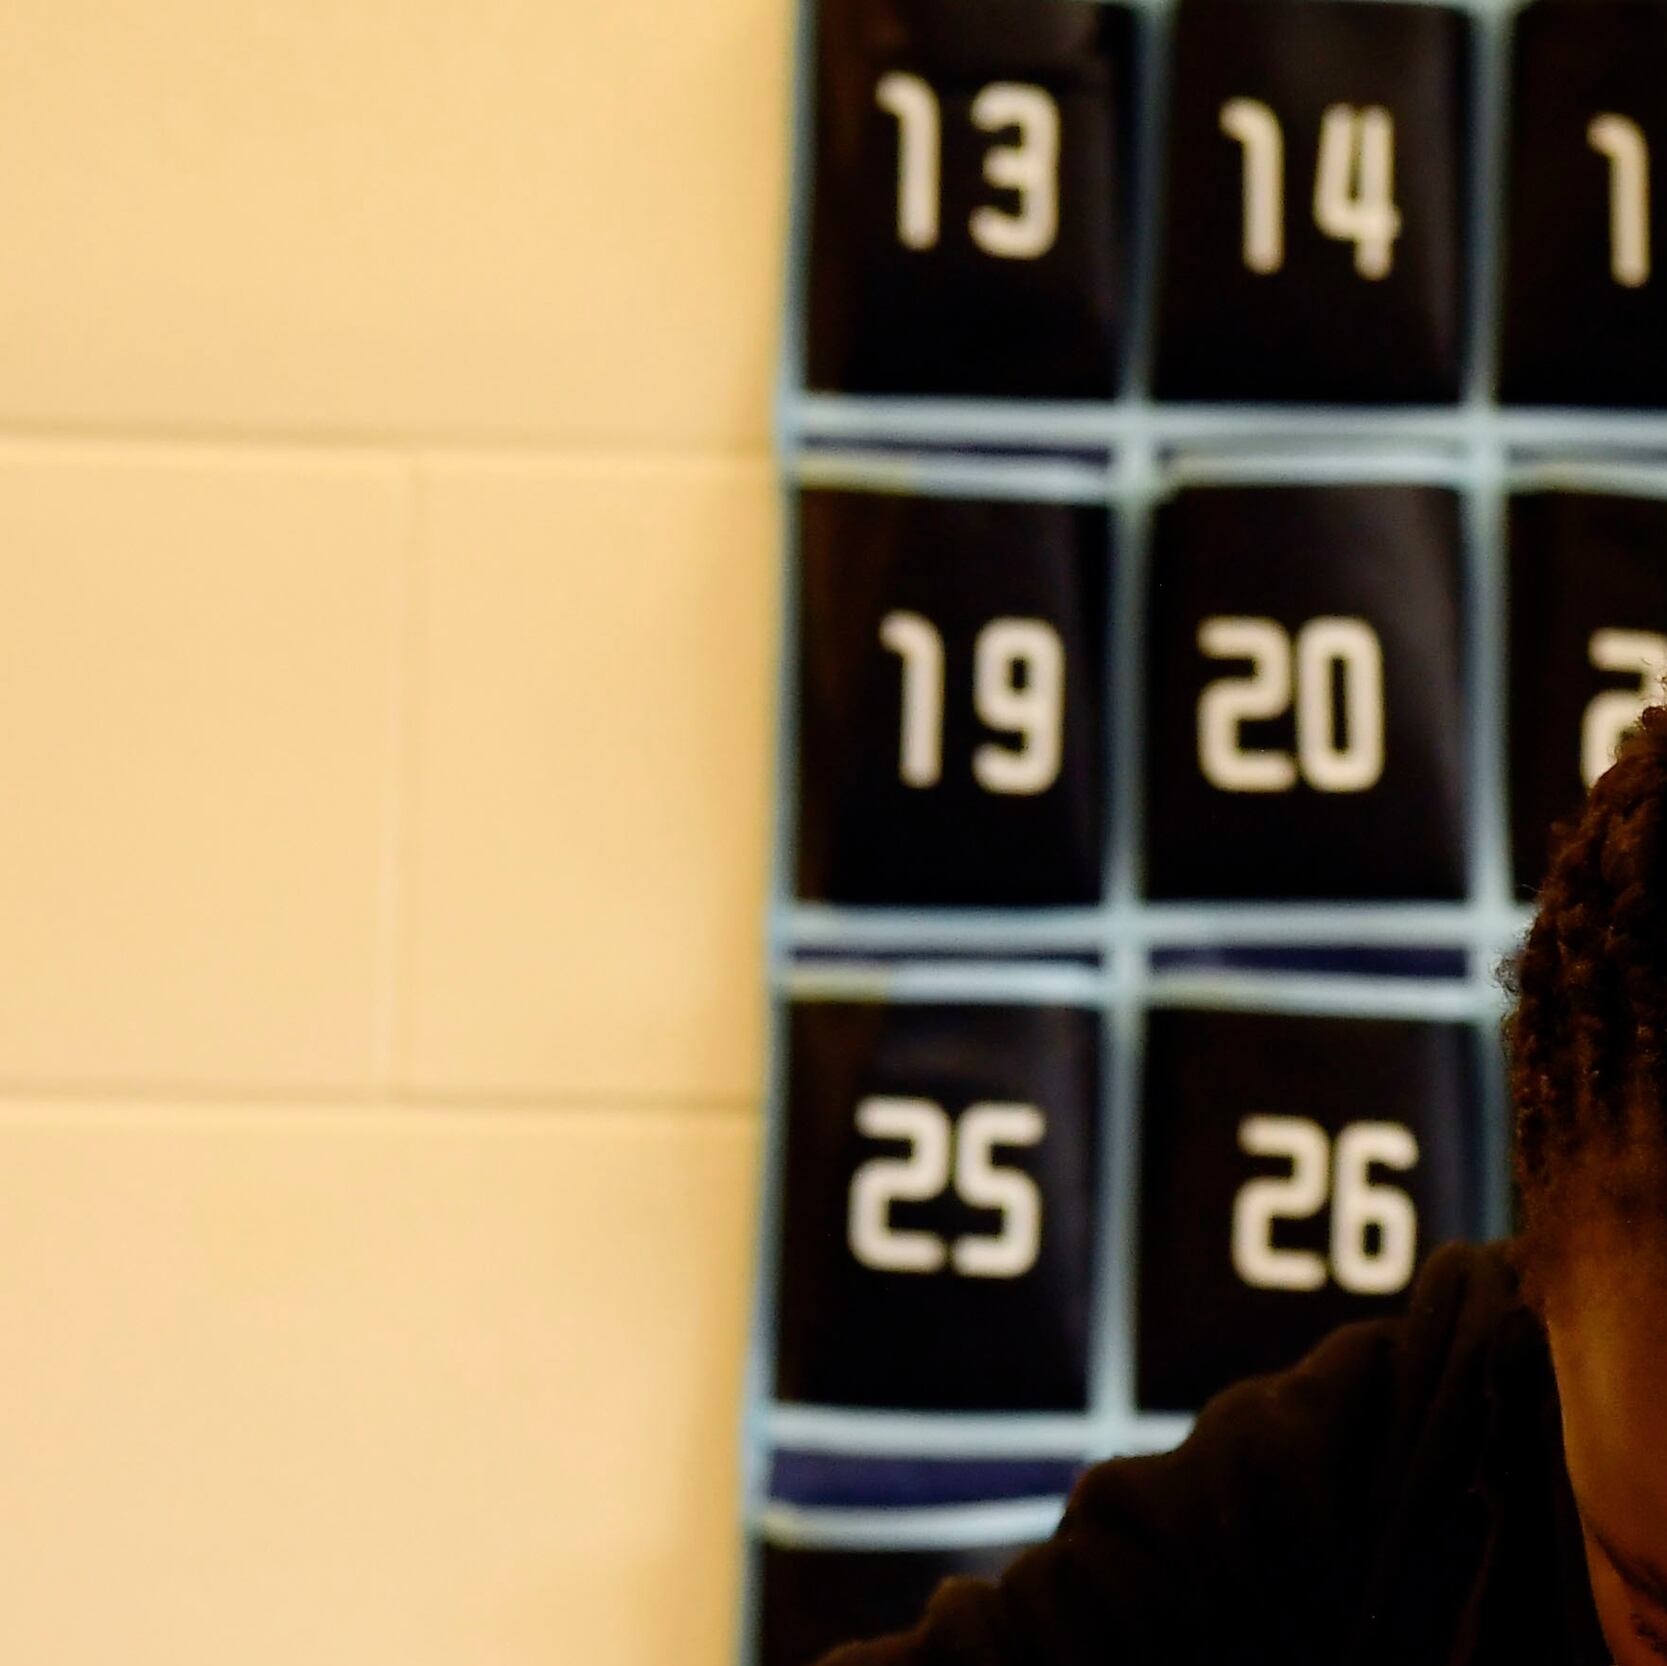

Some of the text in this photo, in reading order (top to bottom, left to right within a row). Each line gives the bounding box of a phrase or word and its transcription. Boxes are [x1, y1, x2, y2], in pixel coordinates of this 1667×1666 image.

[877, 73, 1060, 259] 13
[1220, 99, 1401, 278] 14
[881, 612, 1065, 794] 19
[1197, 616, 1385, 793] 20
[848, 1096, 1046, 1277] 25
[1231, 1115, 1418, 1294] 26
